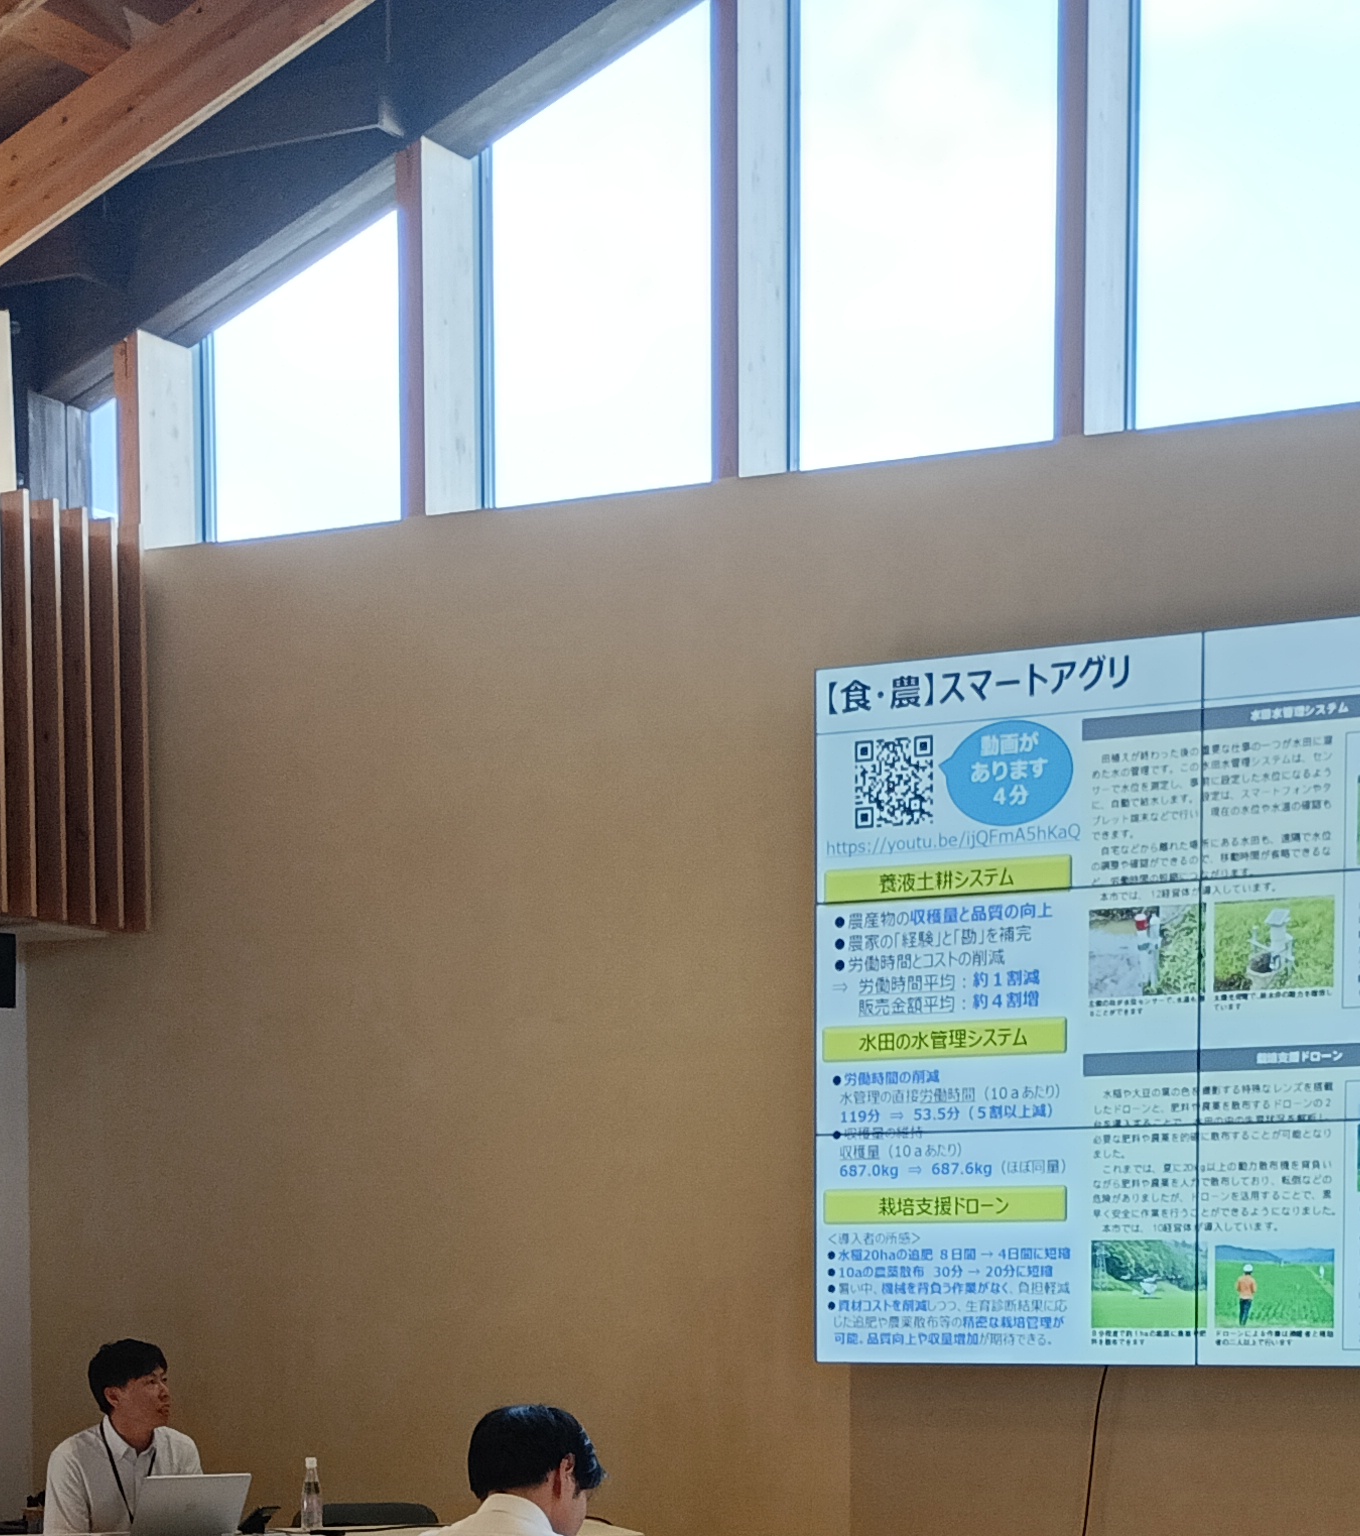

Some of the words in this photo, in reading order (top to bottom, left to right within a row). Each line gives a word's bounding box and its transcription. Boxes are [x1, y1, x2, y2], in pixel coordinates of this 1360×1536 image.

[828, 655, 1131, 715] 【食・農】スマートアグリ
[980, 731, 1039, 758] 動画が
[971, 757, 1049, 783] あります
[993, 785, 1029, 806] 4分
[879, 867, 1014, 894] 養液土耕システム
[848, 903, 1053, 930] 農産物の収穫量と品質の向上
[848, 949, 1005, 973] 労働時間とコストの削減
[858, 1028, 1028, 1052] 水田の水管理システム
[844, 1069, 940, 1087] 労働時間の削減
[840, 1108, 880, 1123] 119分
[839, 1163, 899, 1179] 687.0kg
[878, 1196, 1009, 1218] 栽培支援ドローン
[933, 1265, 963, 1278] 30分
